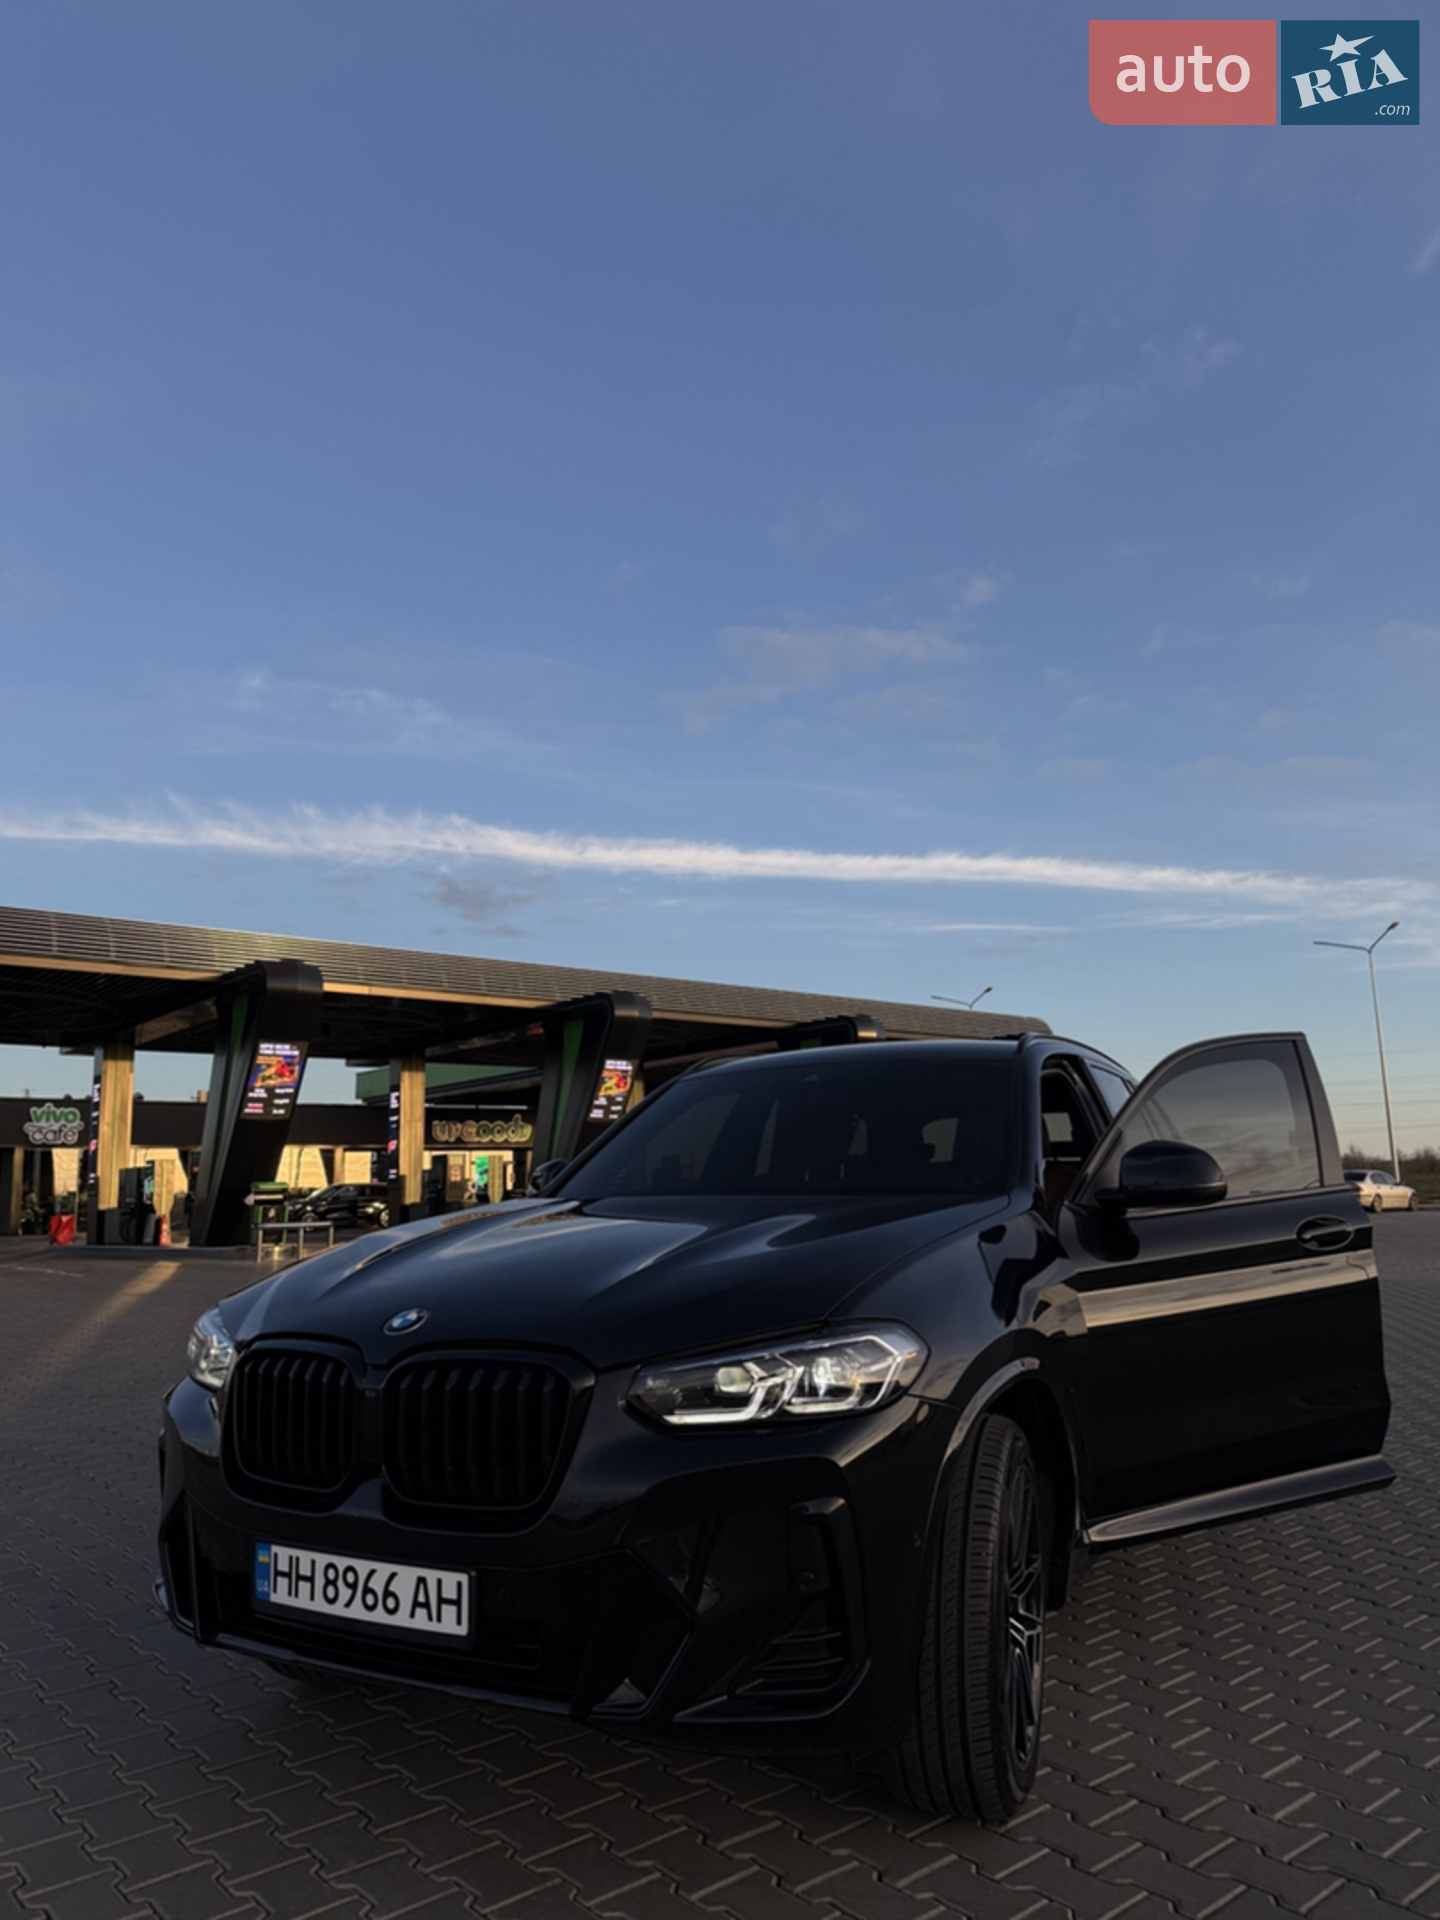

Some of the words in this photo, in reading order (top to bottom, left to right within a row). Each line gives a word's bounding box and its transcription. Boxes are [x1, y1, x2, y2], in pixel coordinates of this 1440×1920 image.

[31, 1105, 79, 1124] vivo
[272, 1552, 316, 1602] HH
[322, 1562, 401, 1616] 8966
[409, 1575, 463, 1626] AH
